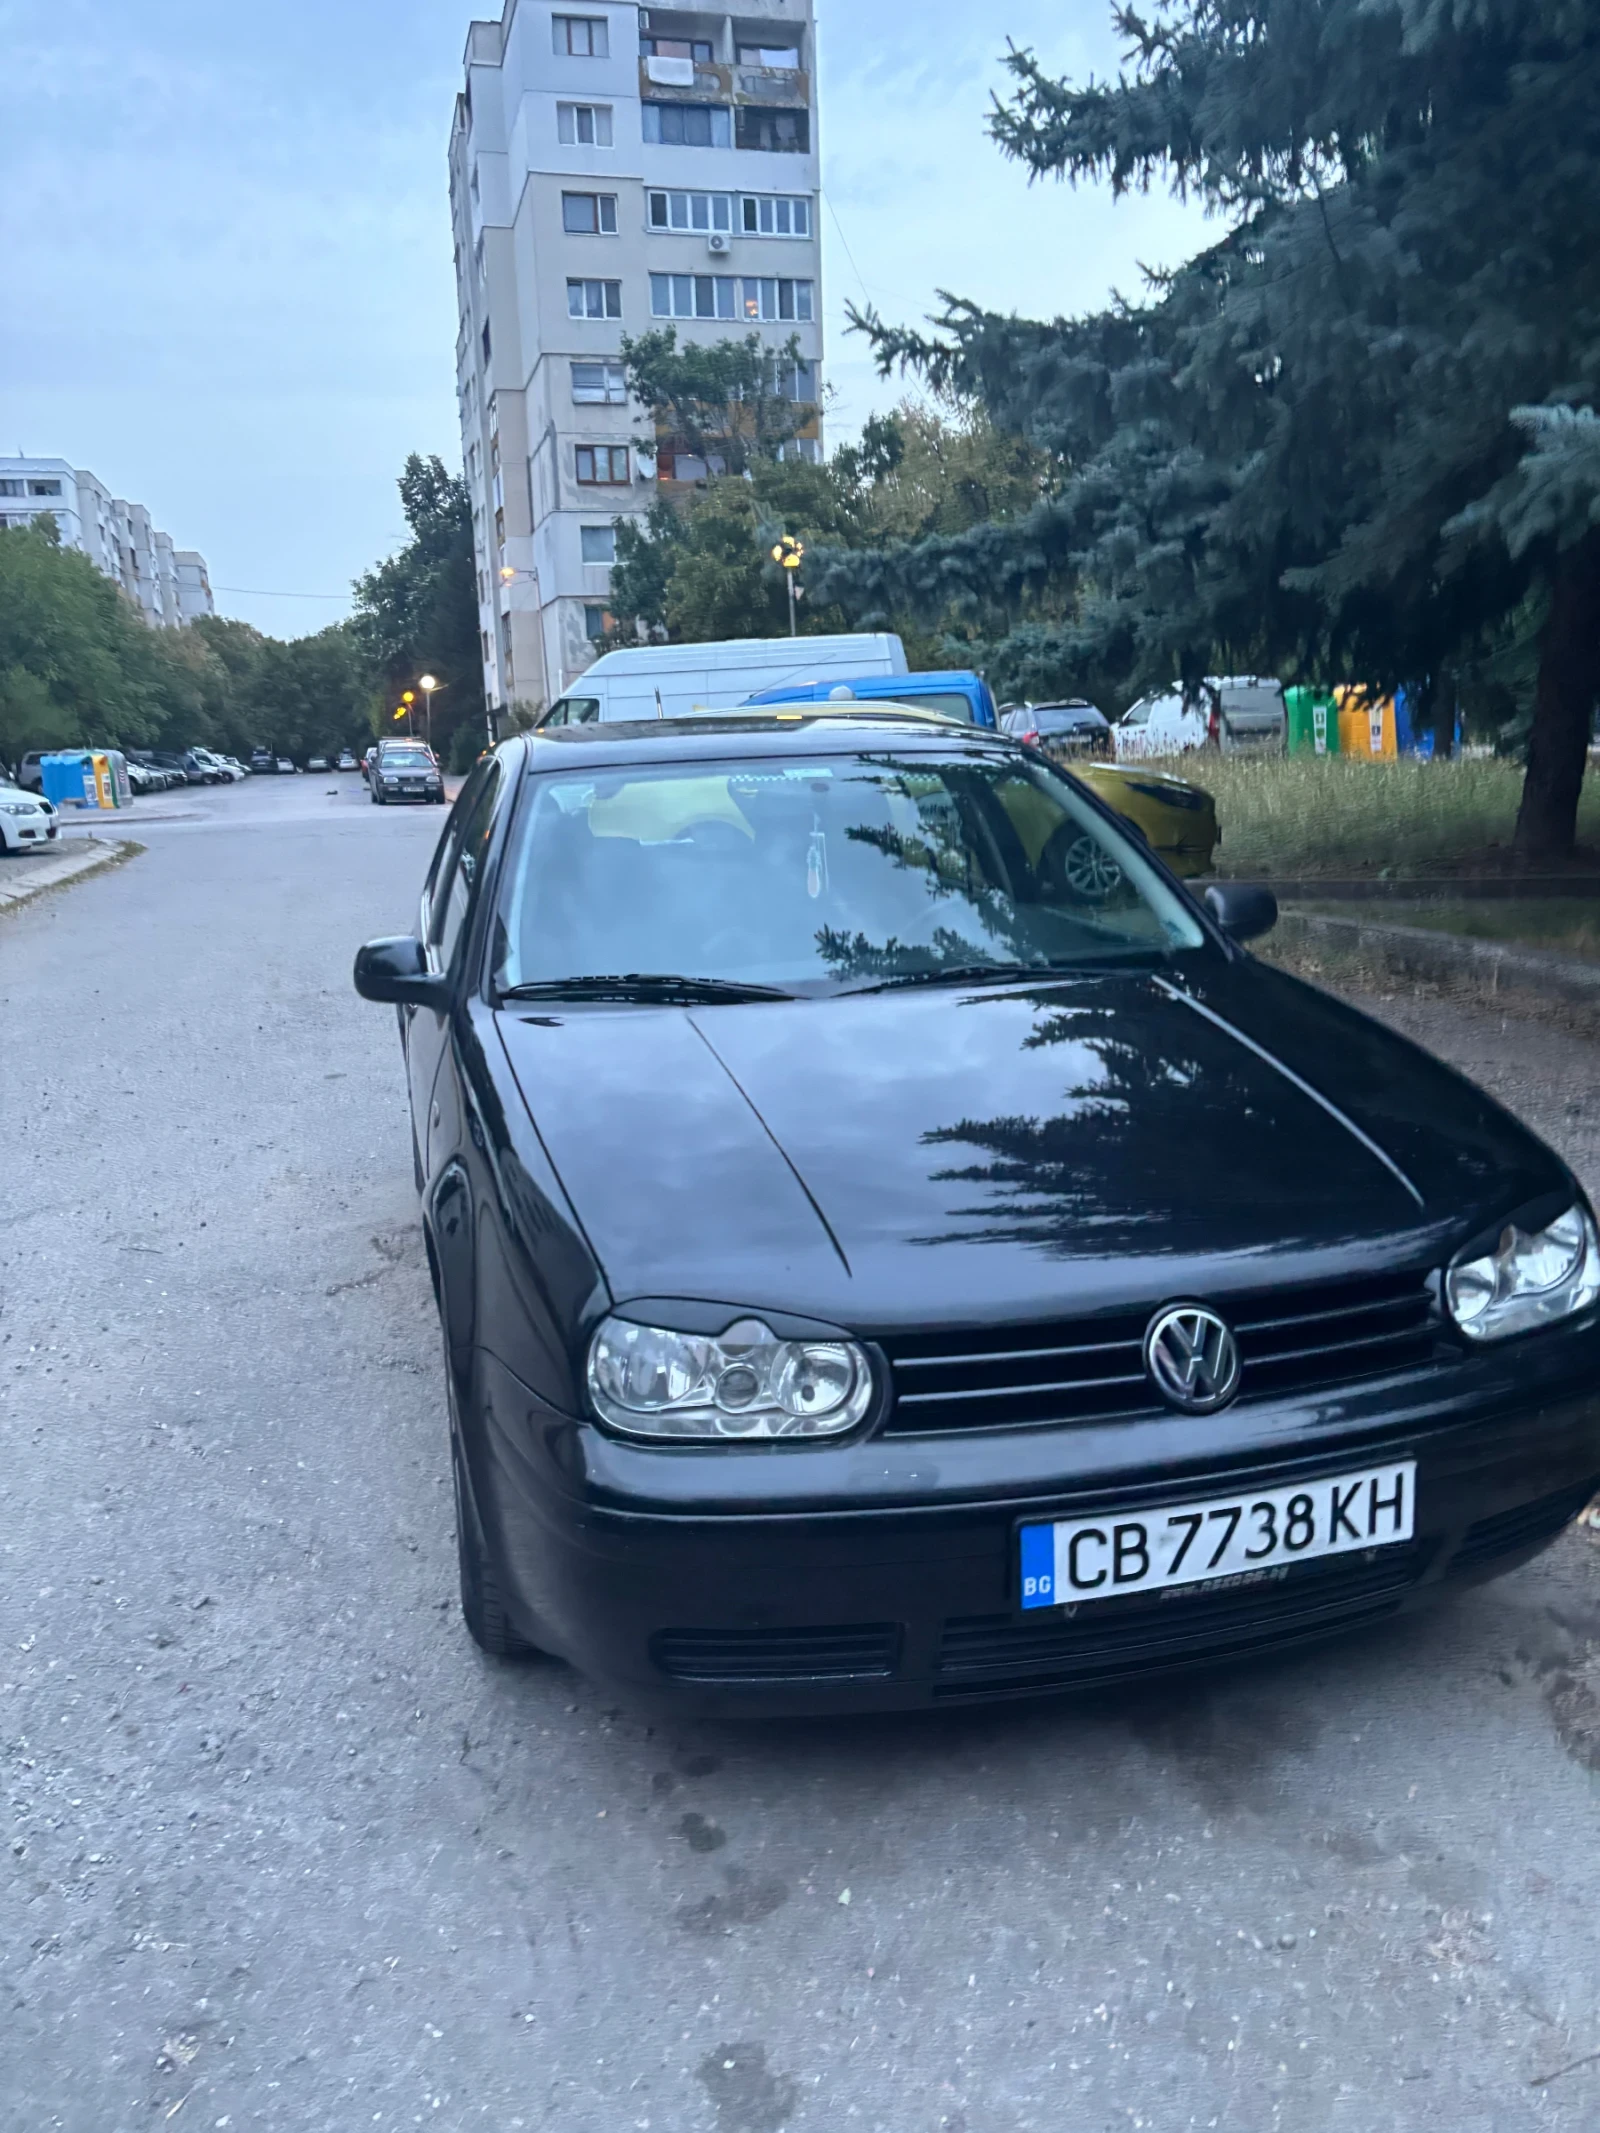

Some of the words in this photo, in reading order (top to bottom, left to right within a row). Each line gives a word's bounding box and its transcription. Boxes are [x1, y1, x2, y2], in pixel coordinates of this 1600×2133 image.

[1149, 1308, 1235, 1405] VW
[1068, 1523, 1150, 1590] CB
[1167, 1494, 1315, 1576] 7738
[1329, 1472, 1404, 1544] KH
[1023, 1575, 1052, 1596] BG
